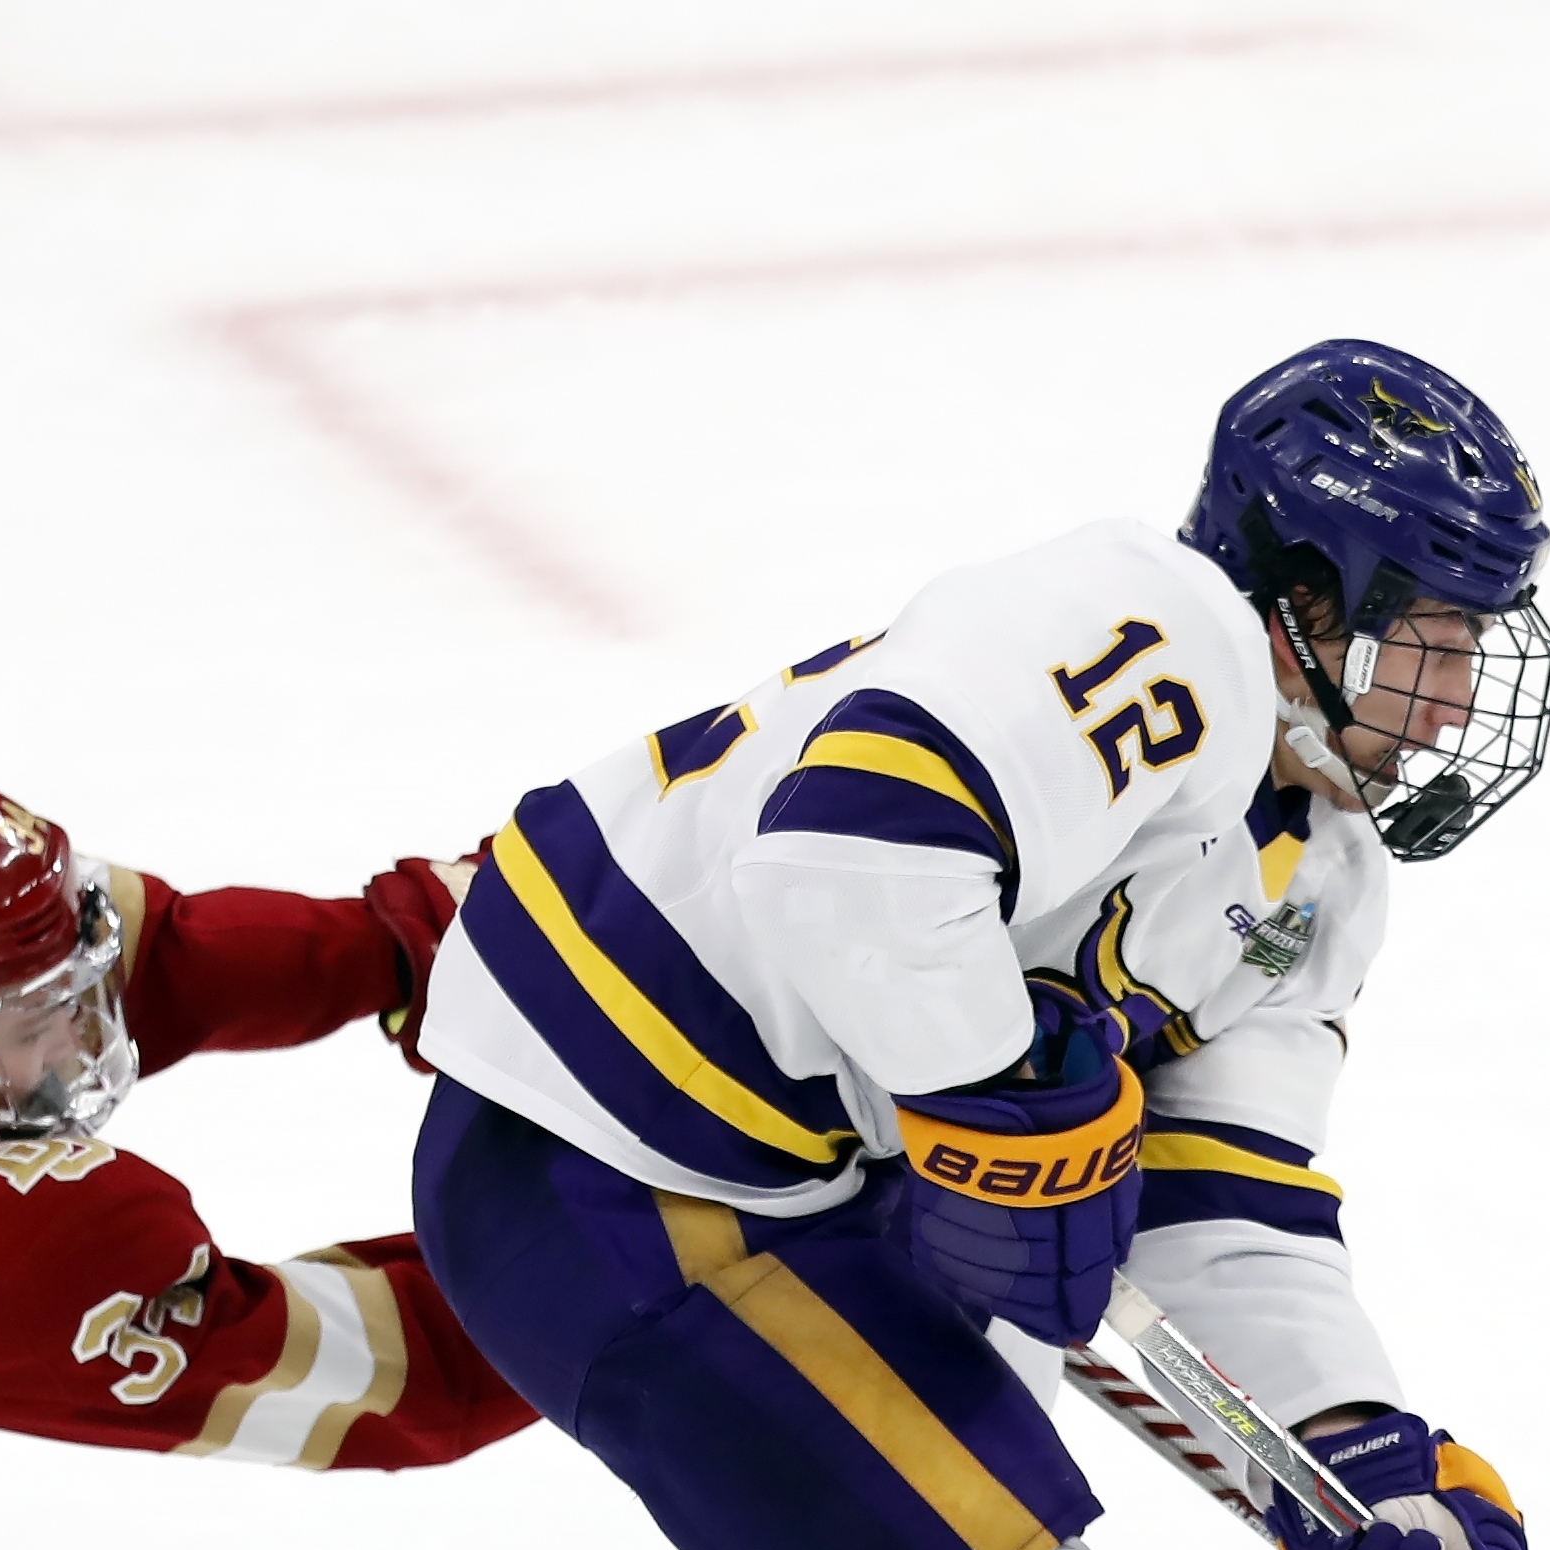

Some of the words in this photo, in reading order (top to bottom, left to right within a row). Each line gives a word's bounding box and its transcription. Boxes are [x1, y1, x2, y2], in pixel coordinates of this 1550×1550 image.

[1276, 597, 1316, 669] BAUER
[1043, 614, 1214, 811] 12
[1328, 1431, 1401, 1467] BAUER
